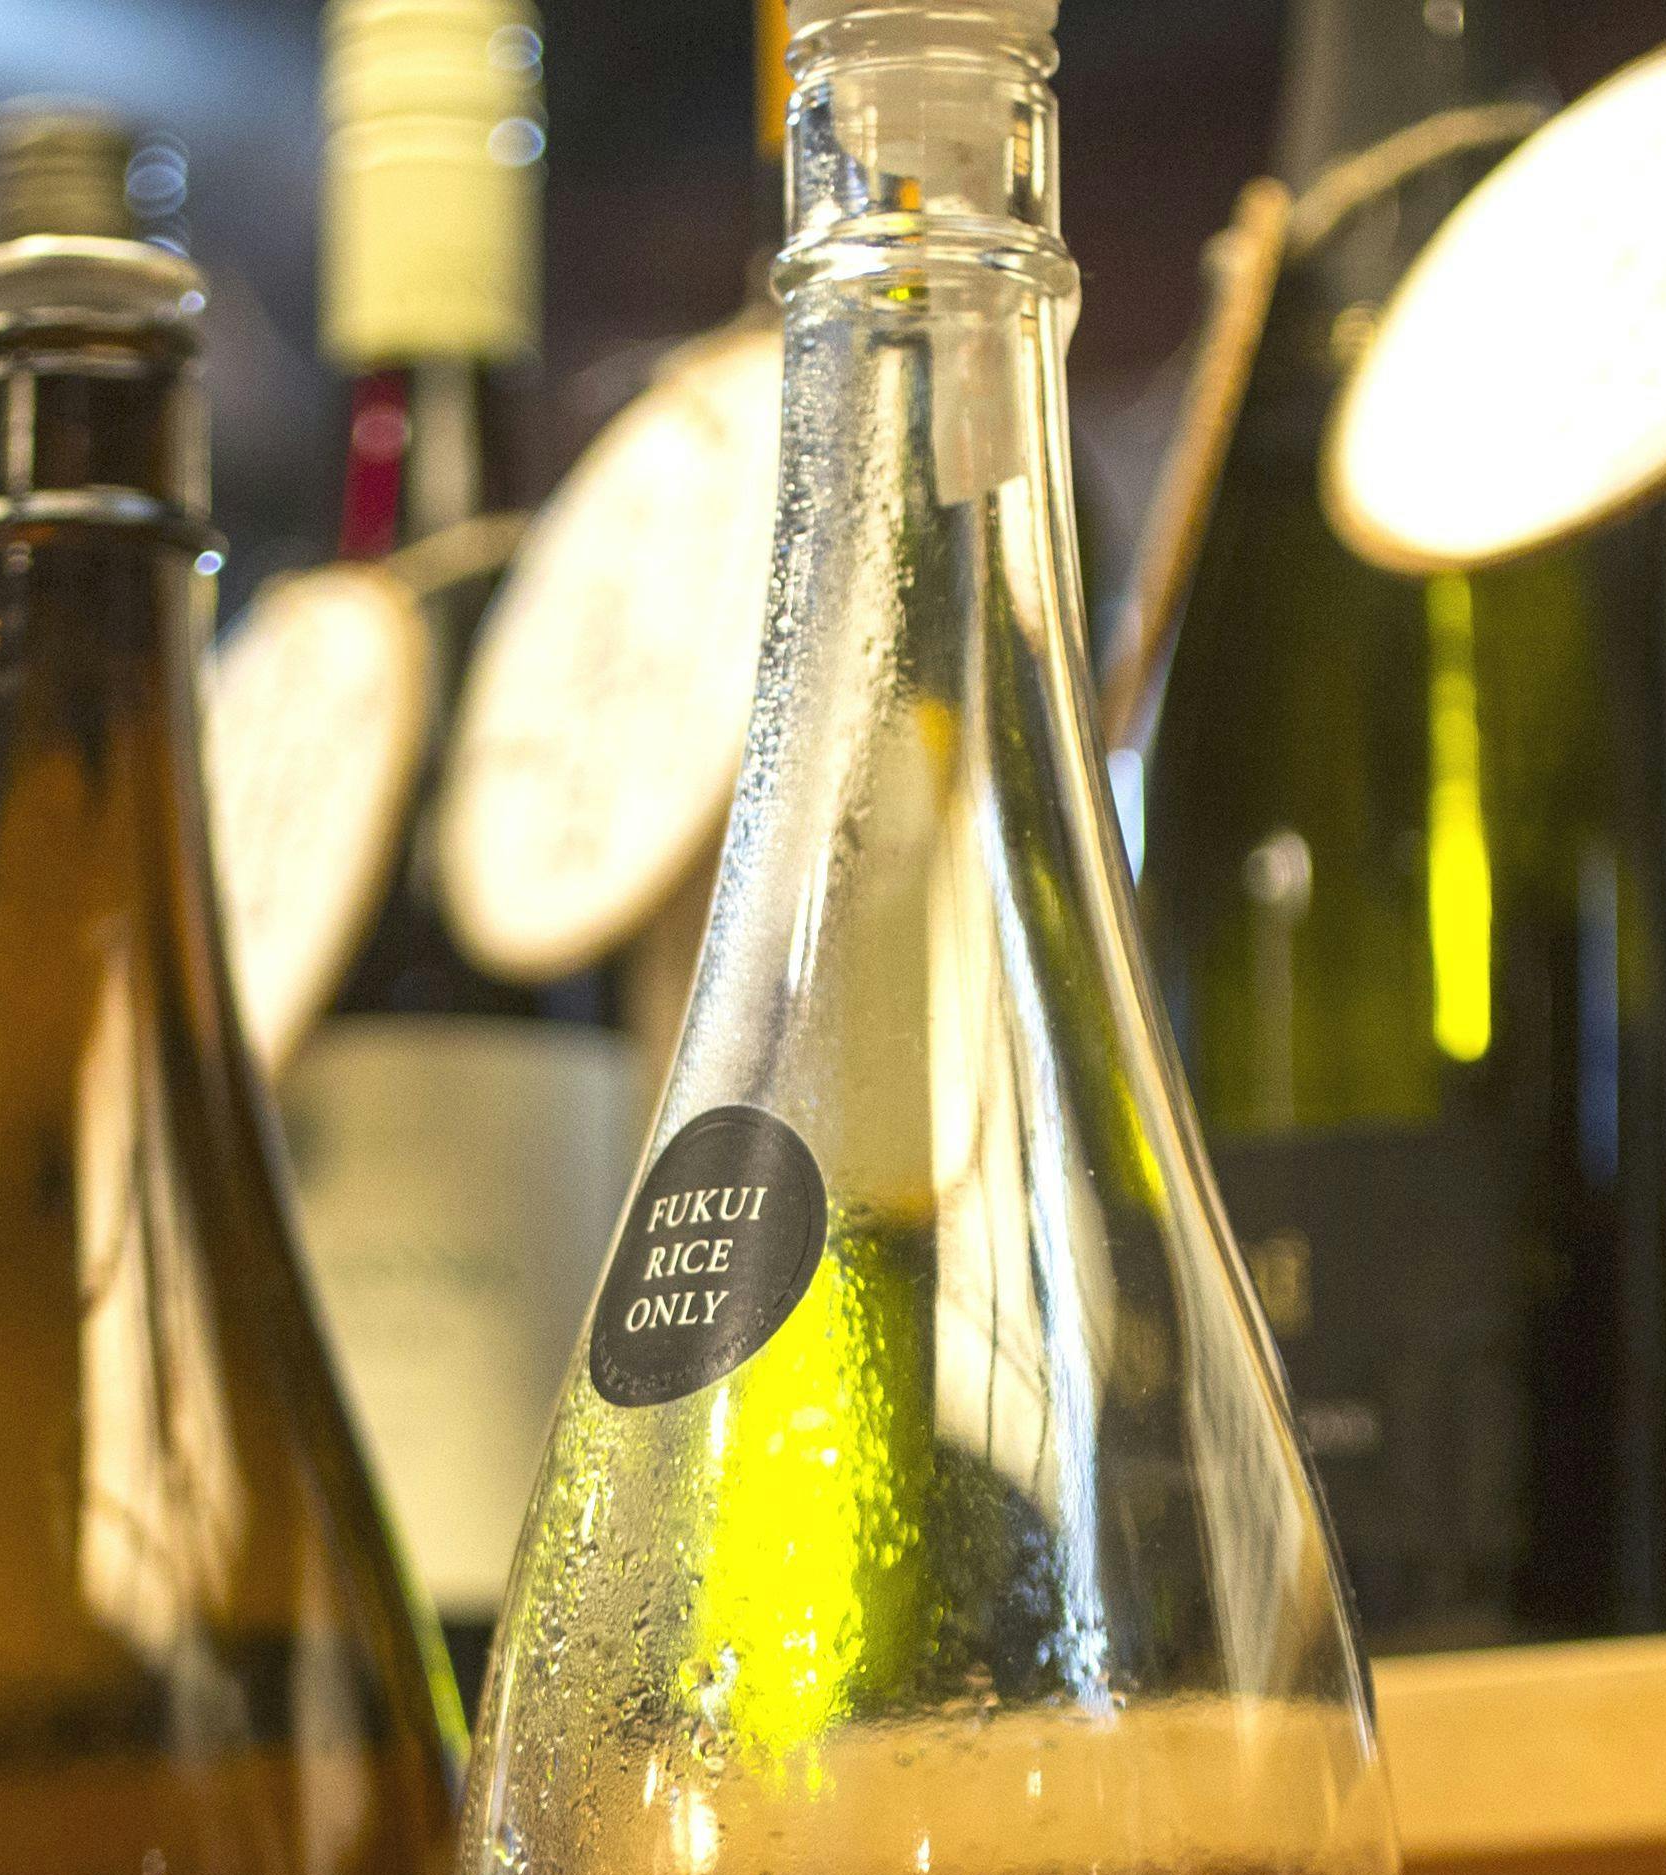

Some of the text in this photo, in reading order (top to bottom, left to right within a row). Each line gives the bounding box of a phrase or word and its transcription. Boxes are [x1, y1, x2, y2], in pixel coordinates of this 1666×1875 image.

[646, 1186, 768, 1234] FUKUI
[644, 1238, 733, 1281] RICE
[626, 1290, 729, 1333] ONLY
